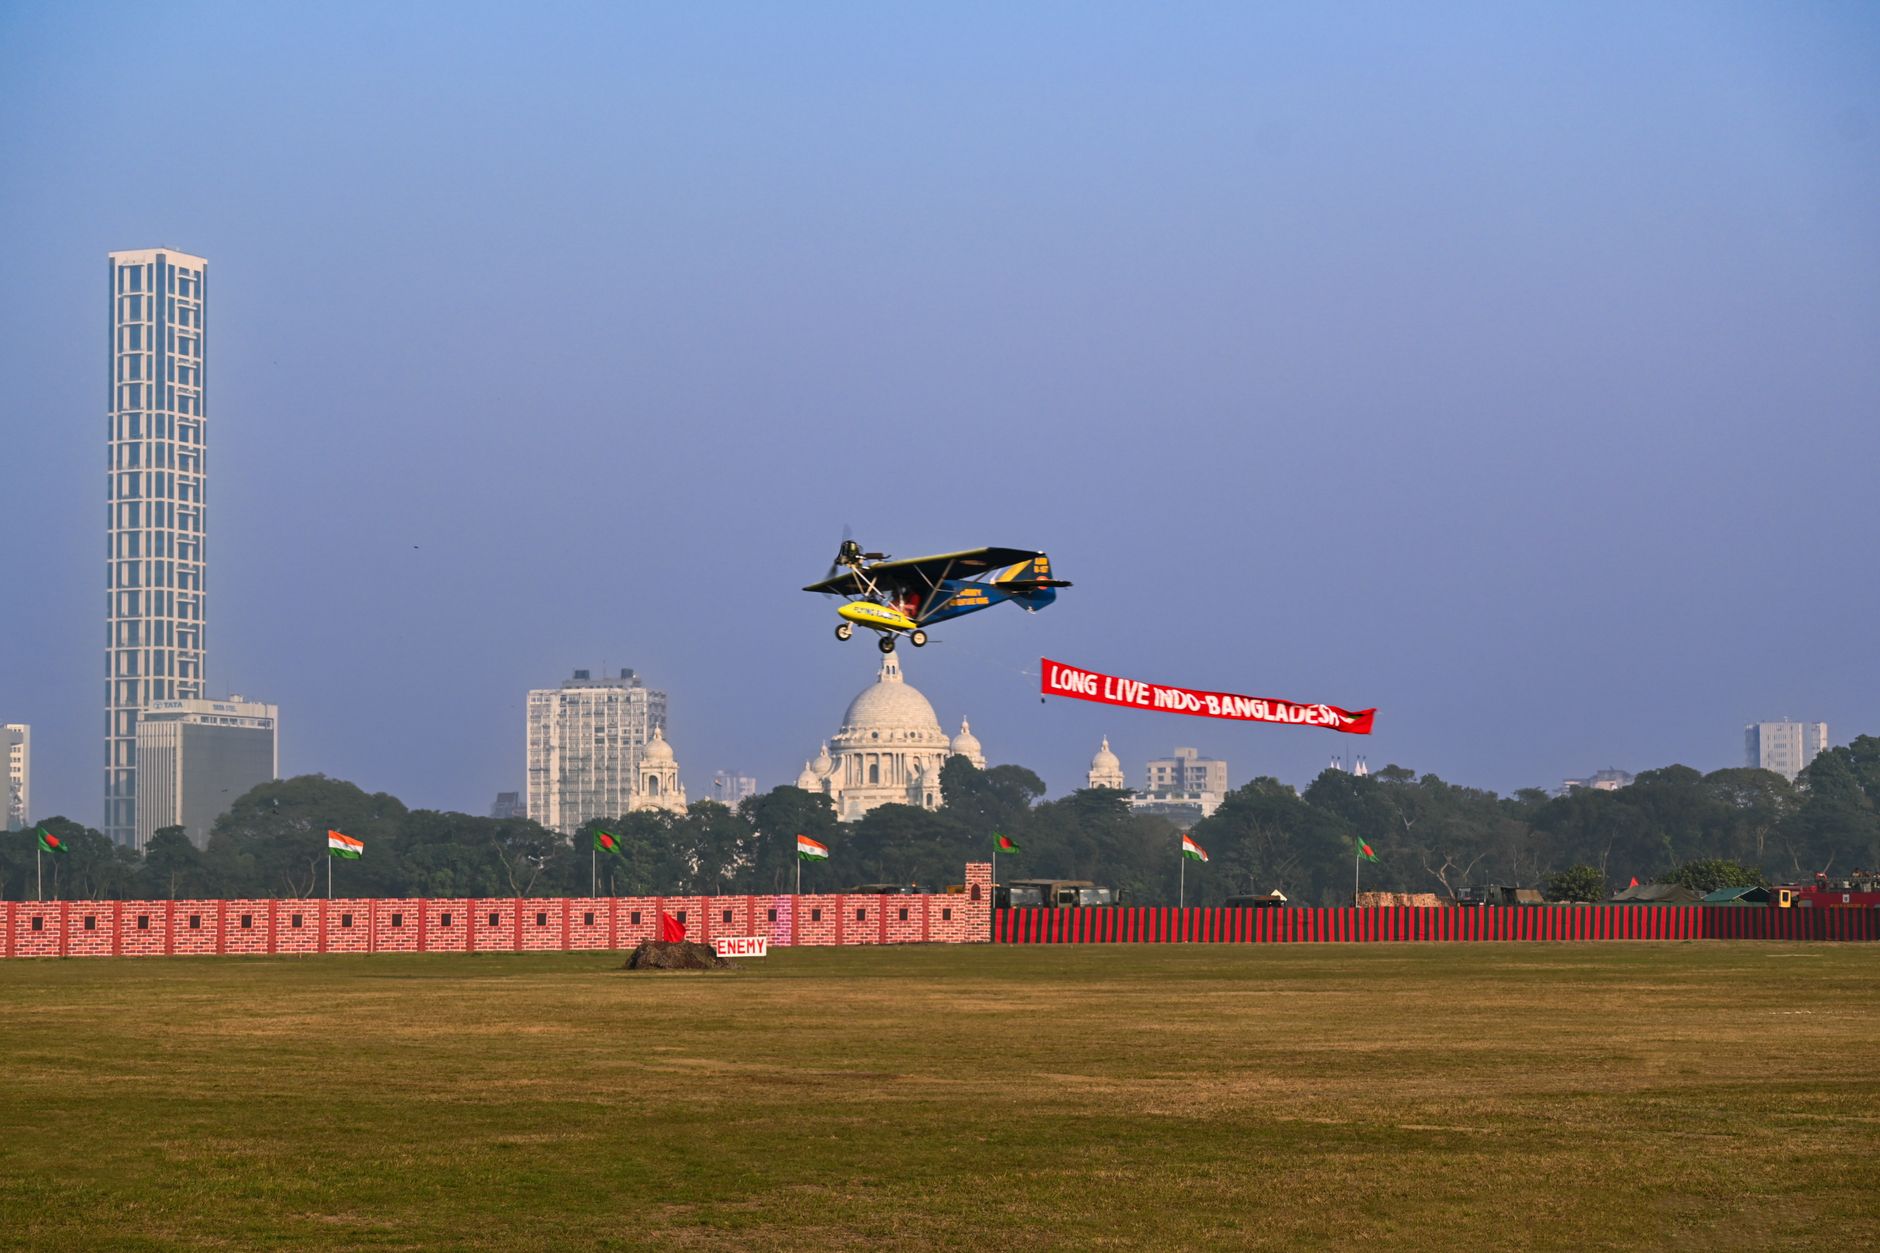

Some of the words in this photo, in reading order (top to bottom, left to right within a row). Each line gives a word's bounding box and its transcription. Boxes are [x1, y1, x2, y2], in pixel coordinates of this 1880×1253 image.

[1051, 665, 1098, 695] LONG
[1104, 677, 1150, 705] LIVE
[717, 939, 764, 954] ENEMY
